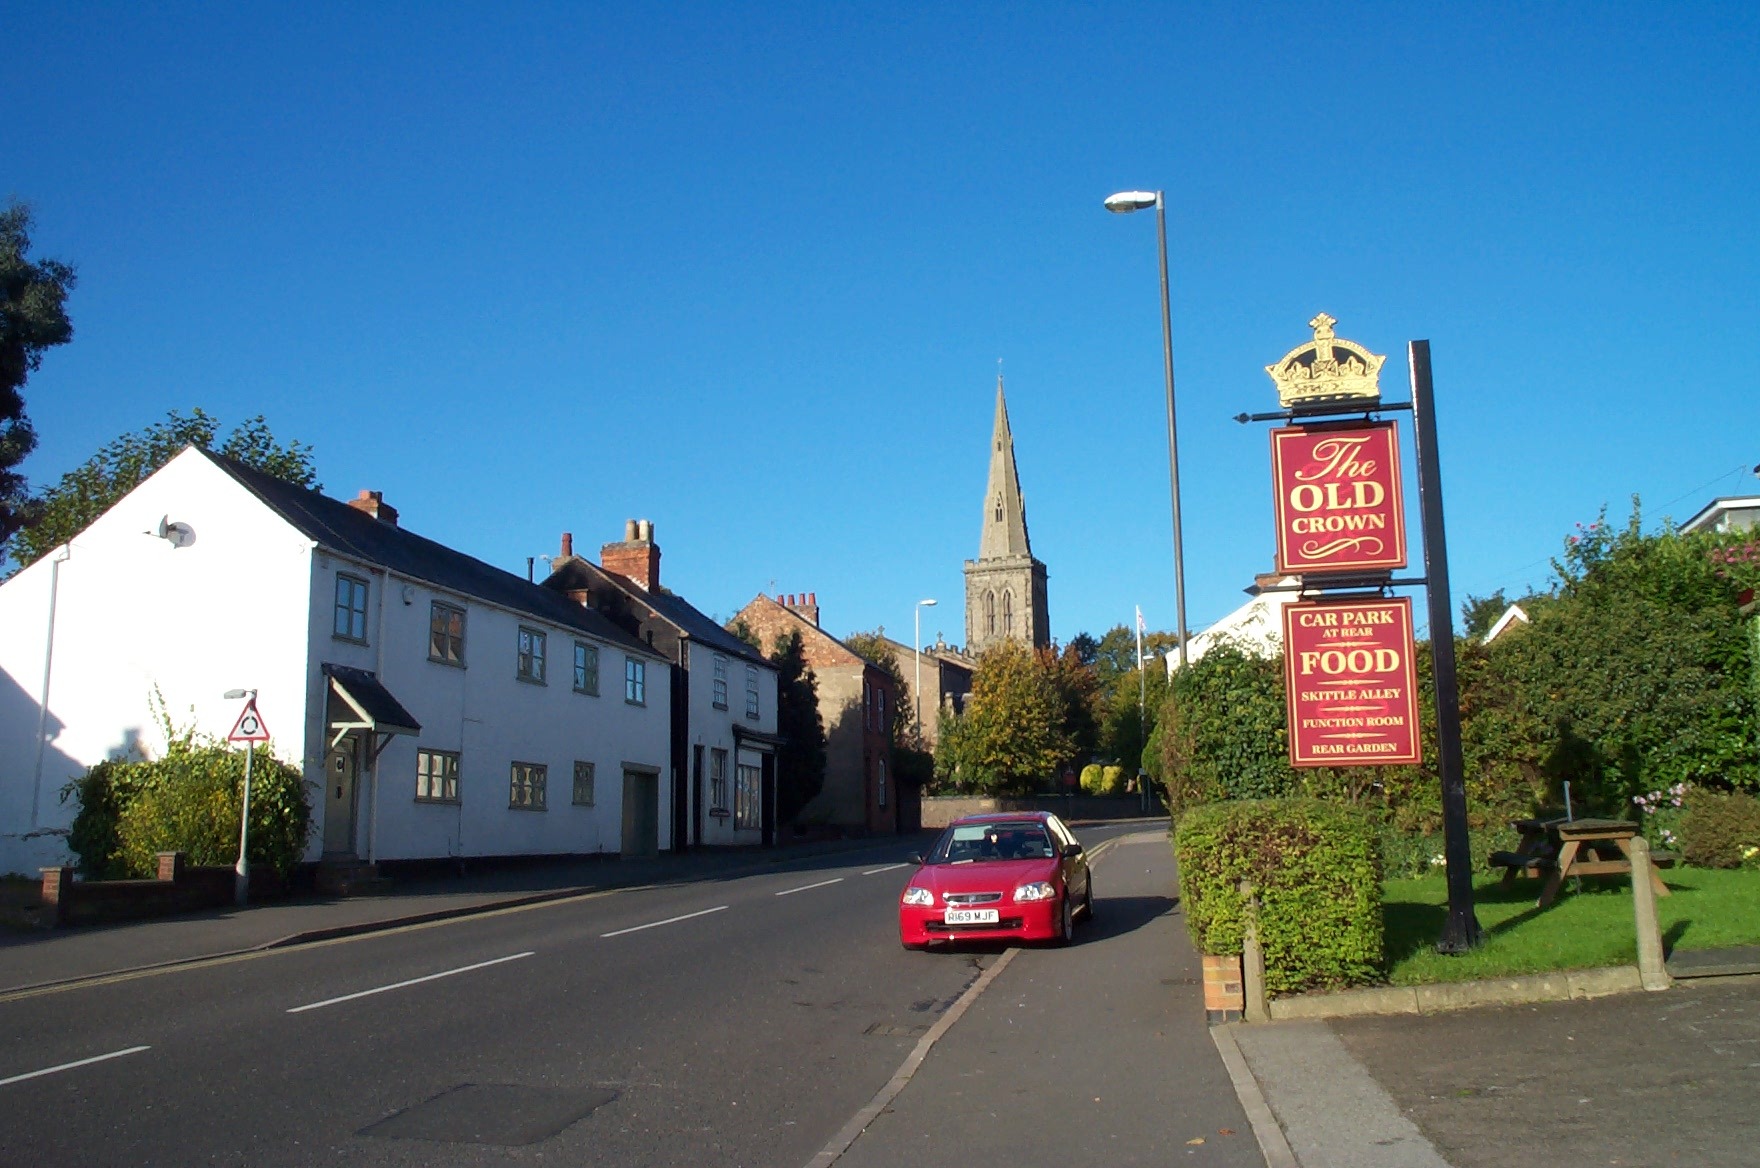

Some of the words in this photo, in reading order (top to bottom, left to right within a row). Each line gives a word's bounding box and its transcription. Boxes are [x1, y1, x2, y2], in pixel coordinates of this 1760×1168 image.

[1294, 436, 1377, 481] The
[1290, 481, 1385, 512] OLD
[1292, 513, 1386, 534] CROWN
[1300, 612, 1338, 627] CAR
[1342, 610, 1394, 626] PARK
[1322, 628, 1339, 638] AT
[1341, 627, 1373, 638] REAR
[1300, 649, 1400, 675] FOOD
[1301, 689, 1357, 702] SKITTLE
[1359, 688, 1401, 699] ALLEY
[1303, 717, 1363, 729] FUNCTION
[1366, 716, 1404, 727] ROOM
[1312, 744, 1345, 755] REAR
[1346, 742, 1397, 754] GARDEN
[948, 911, 971, 921] R169
[974, 910, 995, 921] MJF
